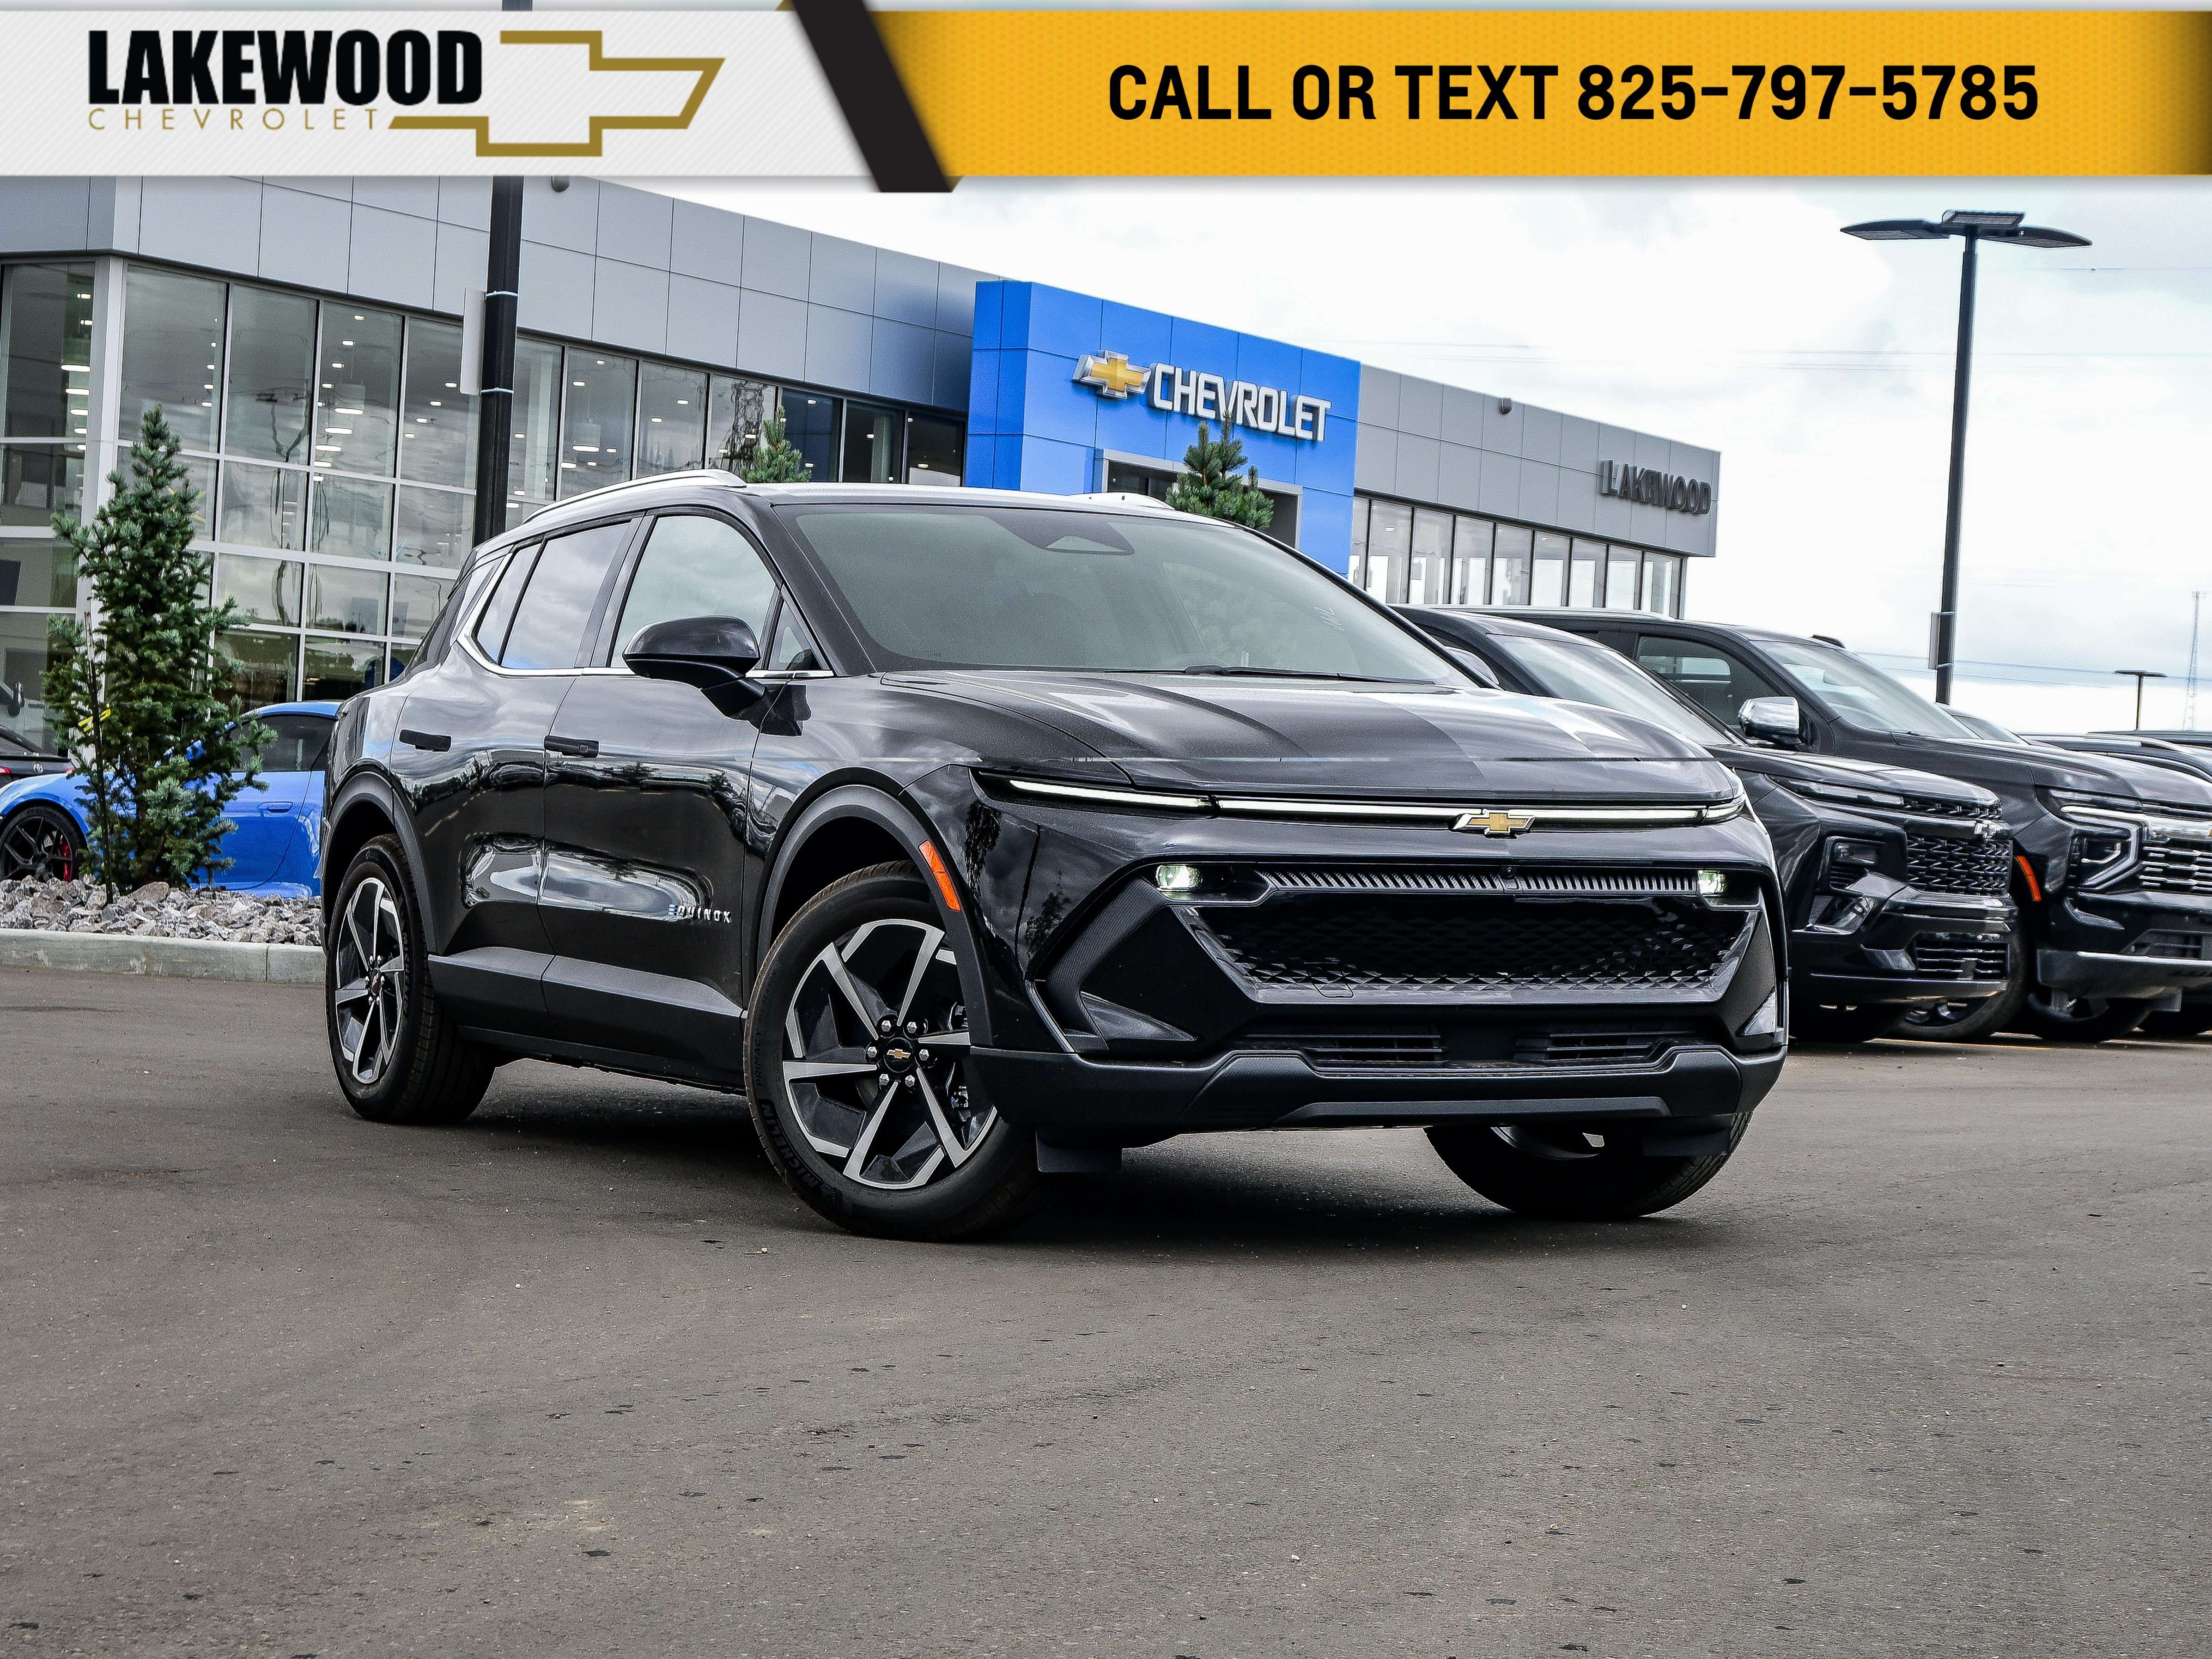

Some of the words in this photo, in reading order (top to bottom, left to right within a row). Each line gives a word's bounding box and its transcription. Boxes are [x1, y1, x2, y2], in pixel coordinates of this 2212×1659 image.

[1150, 362, 1331, 442] CHEVROLET
[1600, 459, 1712, 514] LAKEWOOD
[668, 904, 732, 923] EQUINOX
[754, 1028, 763, 1086] PRIMACY
[761, 1103, 820, 1187] MICHELIN
